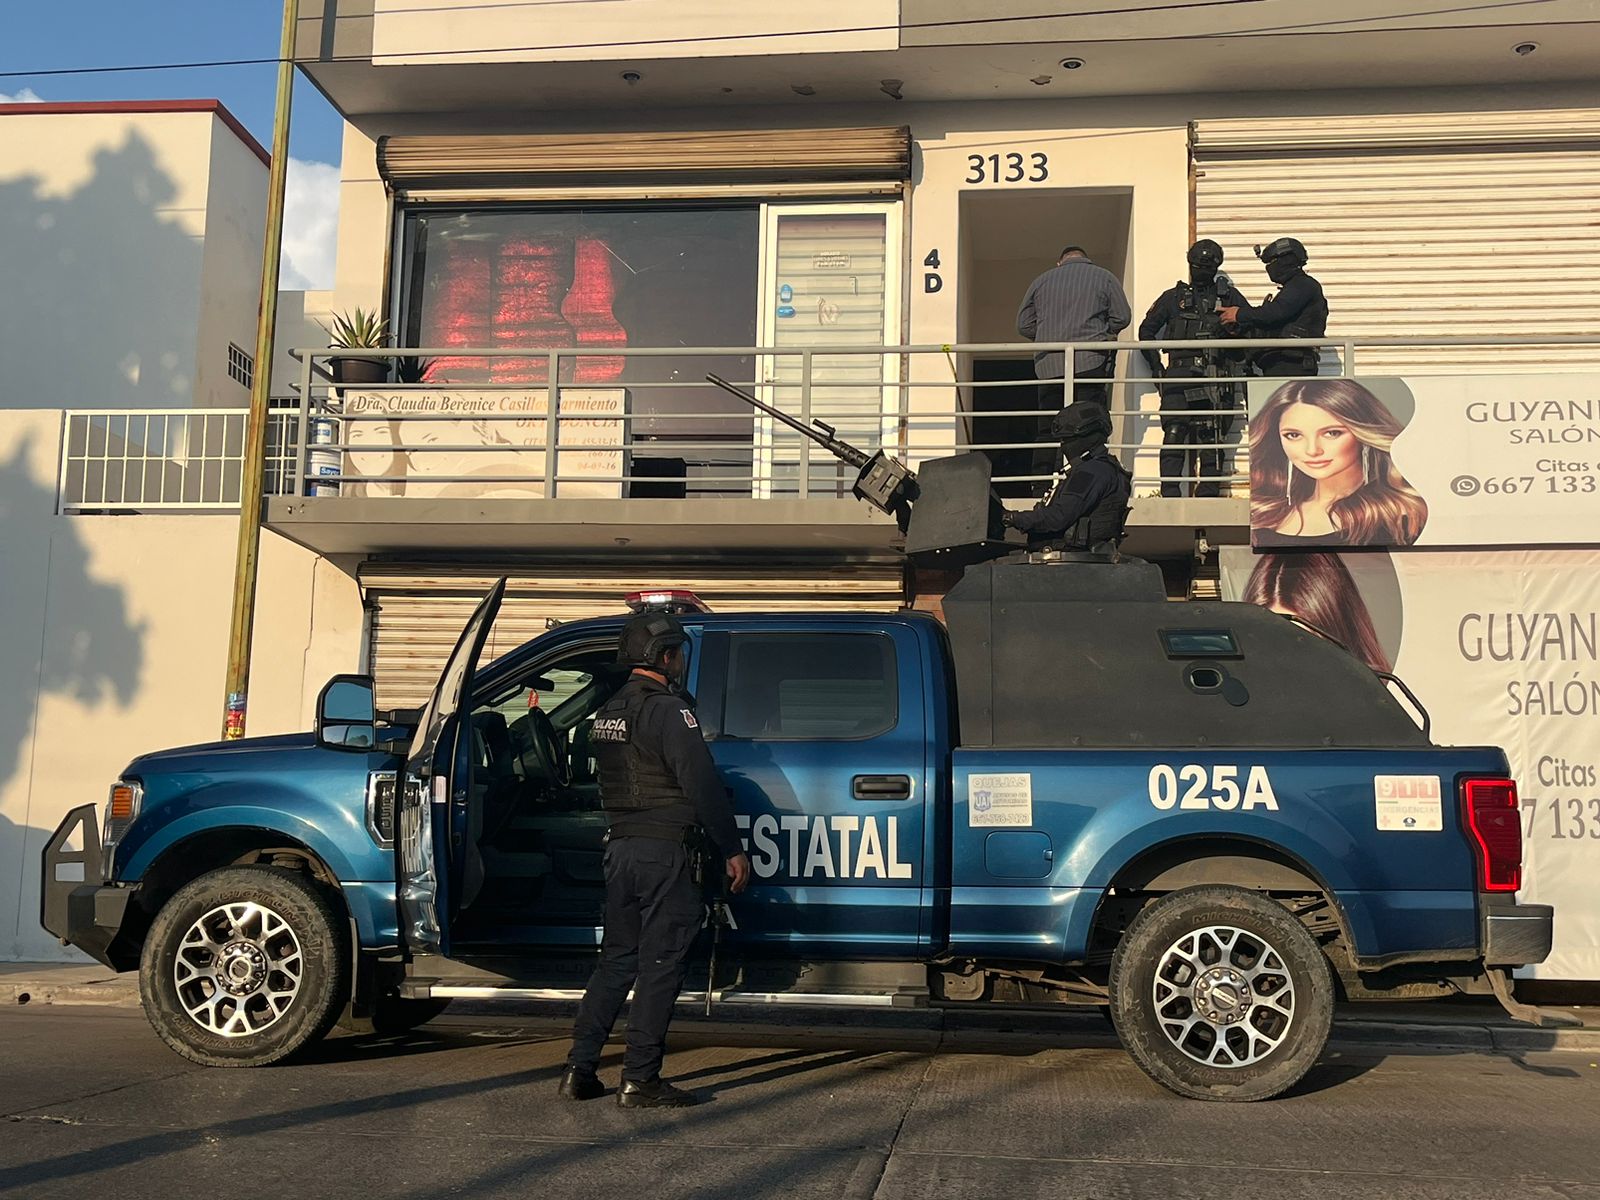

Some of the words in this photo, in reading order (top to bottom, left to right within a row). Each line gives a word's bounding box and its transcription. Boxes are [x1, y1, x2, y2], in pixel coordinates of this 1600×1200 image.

[966, 153, 1048, 183] 3133
[924, 249, 940, 269] 4
[925, 273, 942, 294] D
[356, 396, 382, 411] Dra.
[388, 396, 437, 411] Claudia
[440, 396, 495, 411] Berenice
[560, 396, 618, 411] armiento
[1536, 459, 1589, 472] Citas
[1484, 477, 1535, 494] 667
[1545, 476, 1596, 493] 133
[1537, 755, 1597, 786] Citas
[973, 777, 1026, 788] QUEJAS
[1148, 764, 1278, 811] 025A
[1381, 779, 1434, 796] 911
